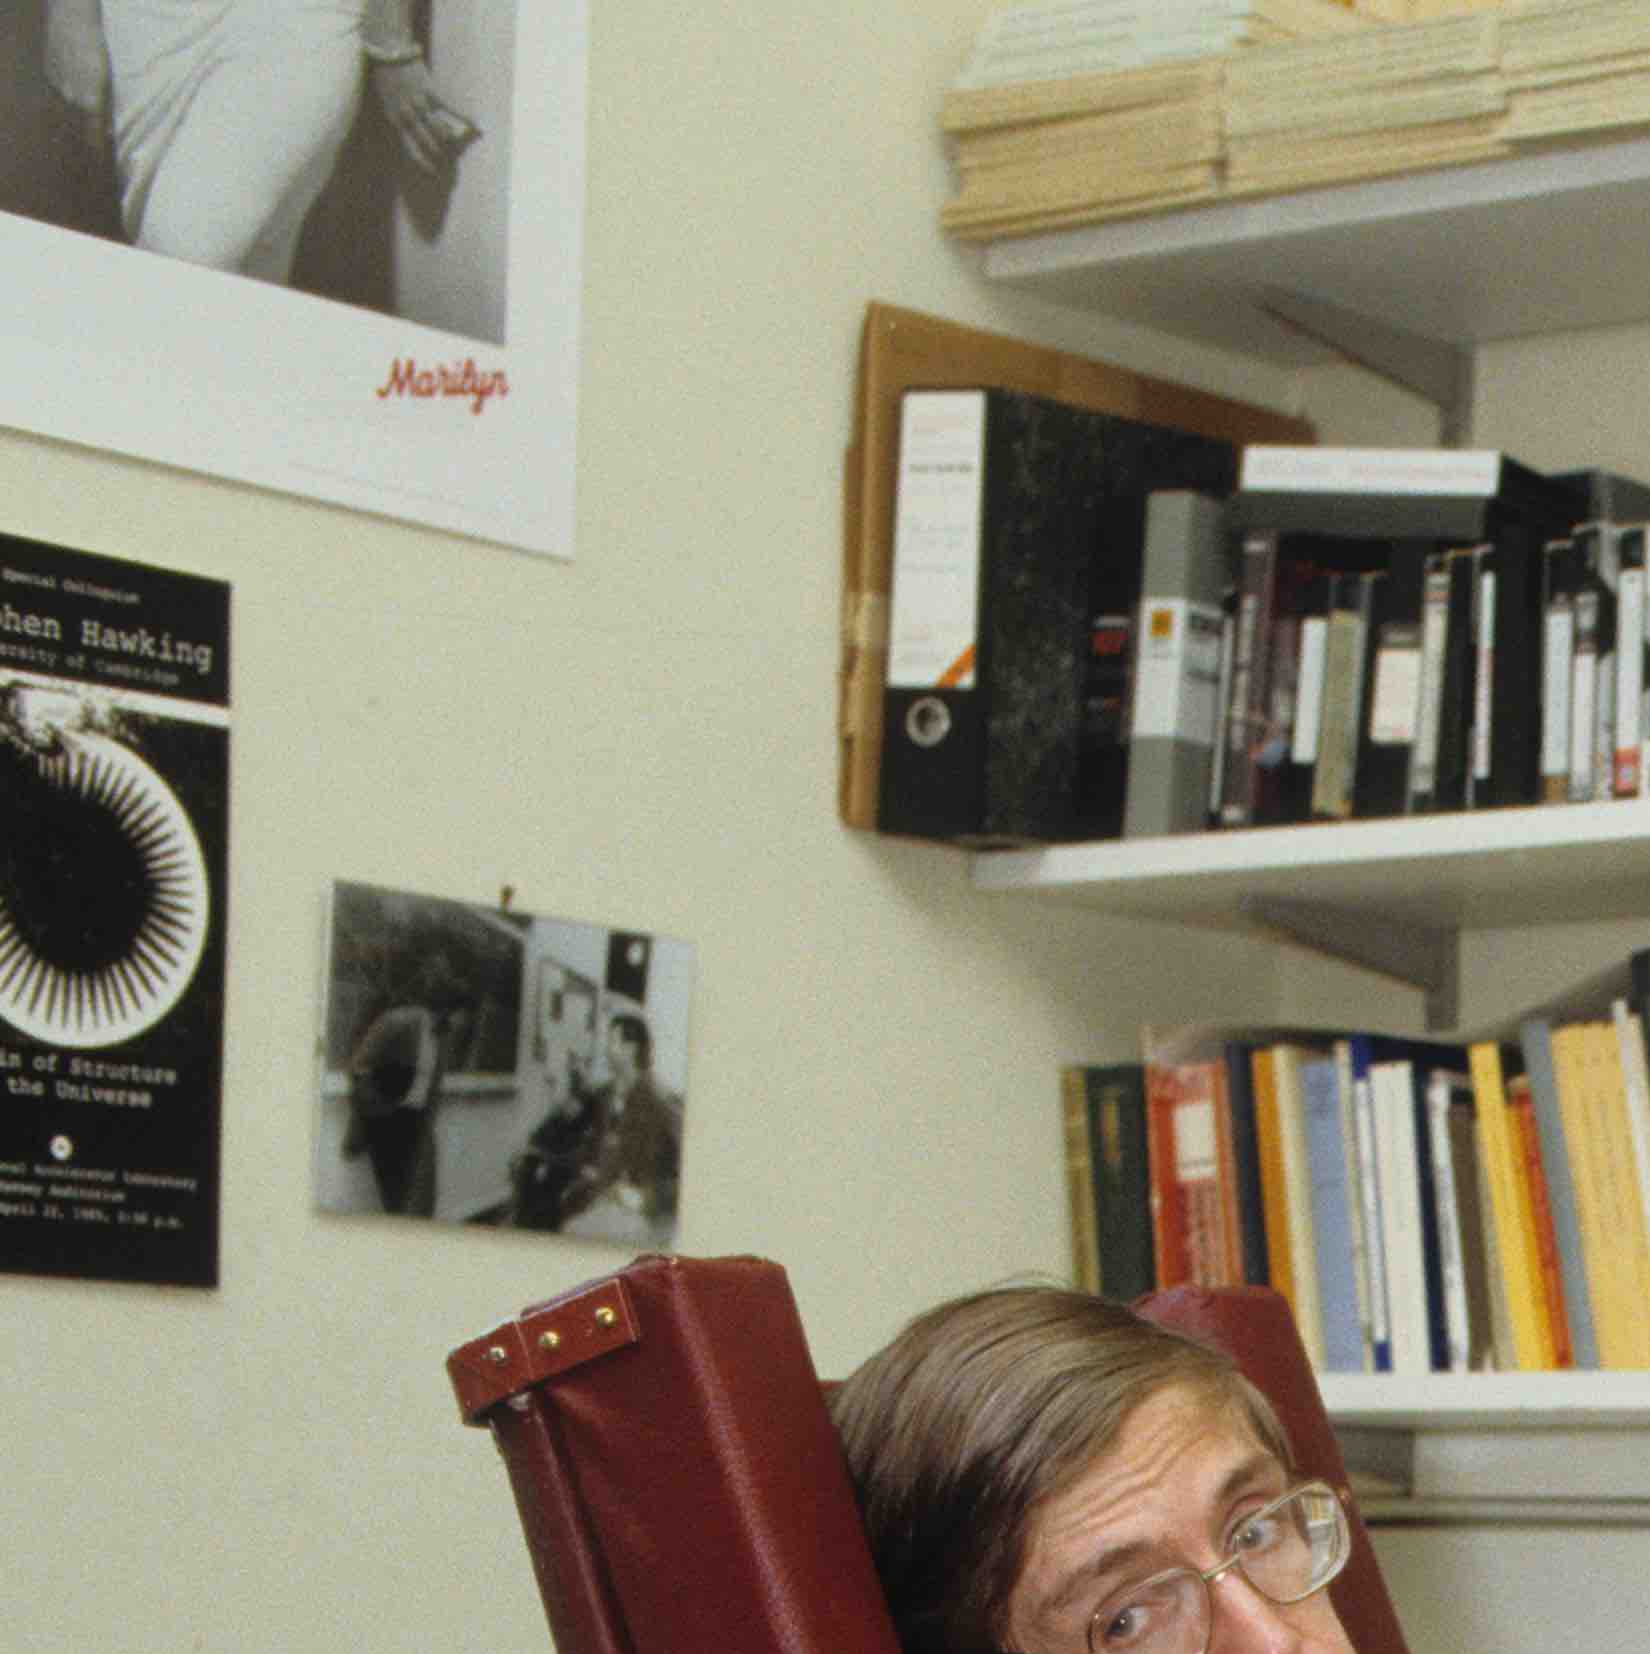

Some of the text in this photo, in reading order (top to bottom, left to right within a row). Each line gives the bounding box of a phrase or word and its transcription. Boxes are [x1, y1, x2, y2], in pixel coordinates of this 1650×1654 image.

[375, 357, 511, 415] Marilyn
[80, 618, 214, 676] Hawking
[6, 1075, 154, 1110] the Universe
[32, 1053, 58, 1073] of
[69, 1057, 179, 1087] Structure
